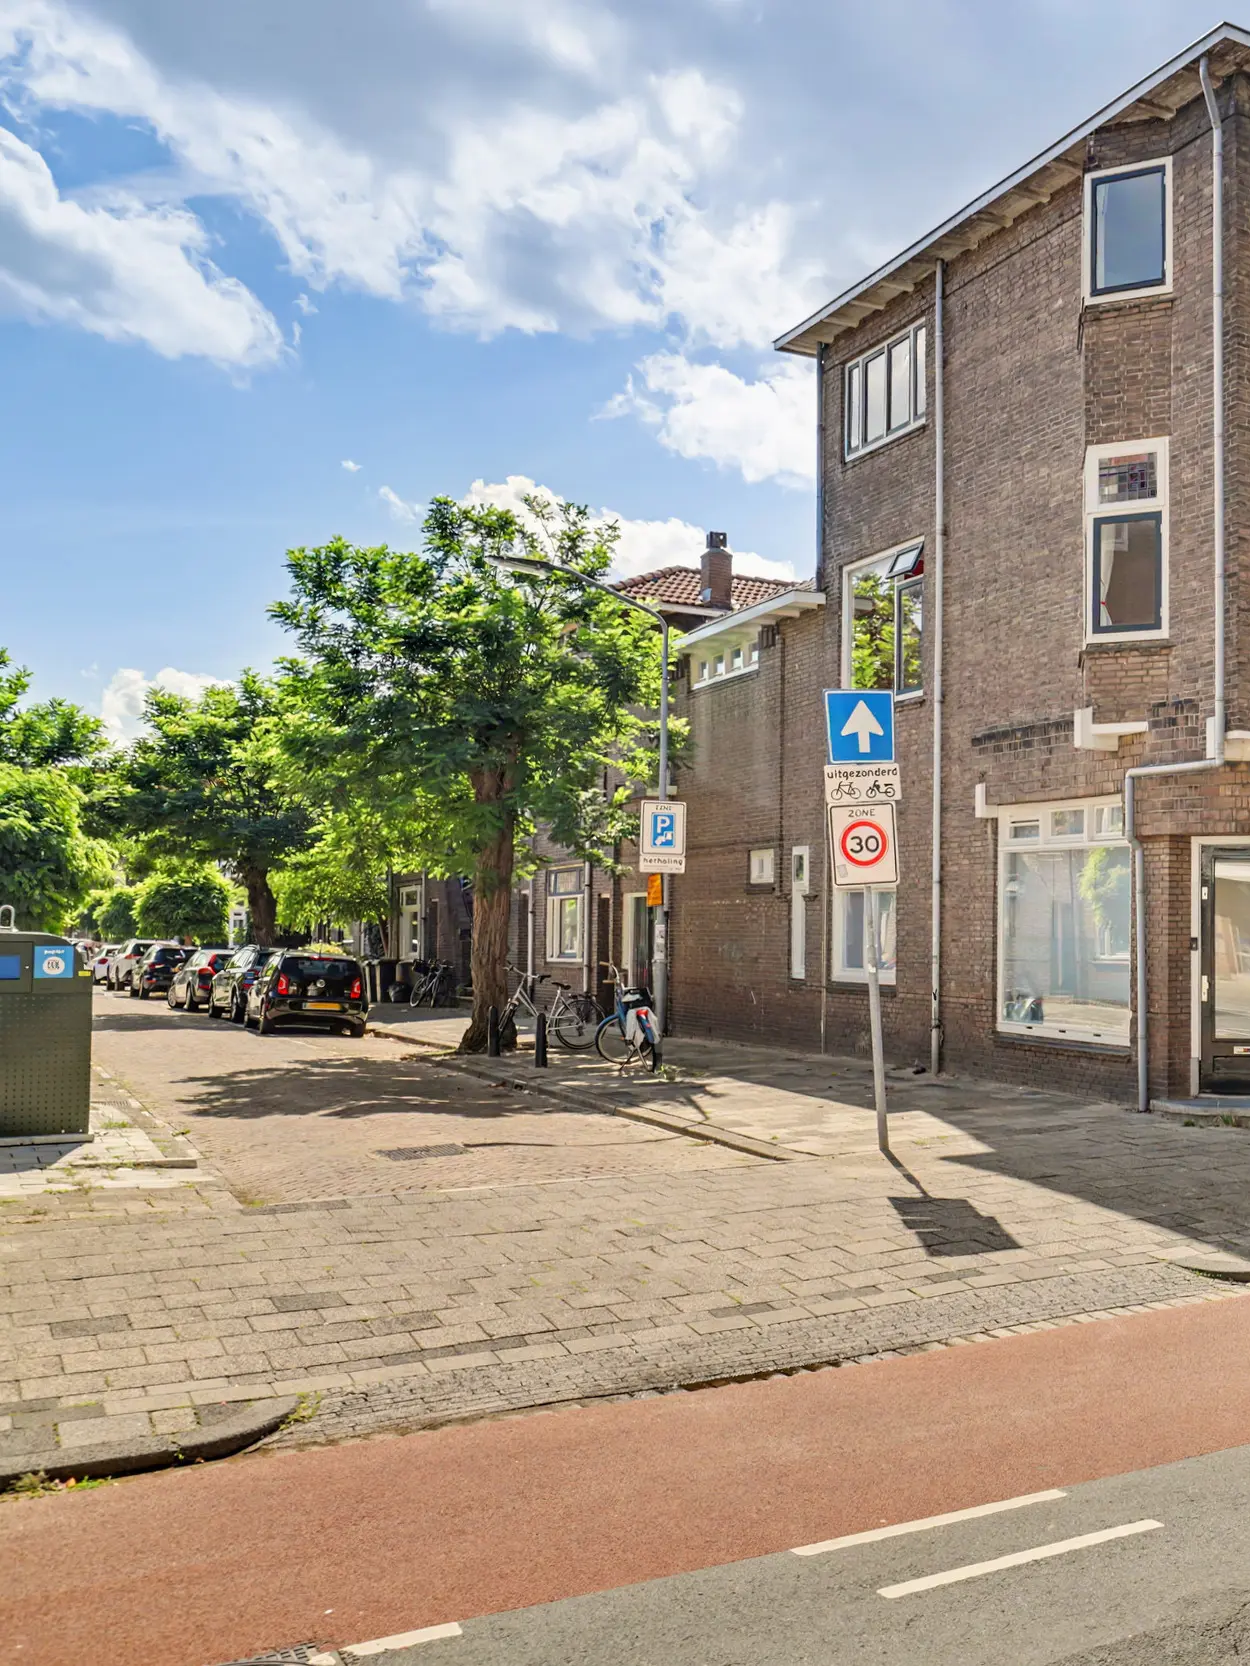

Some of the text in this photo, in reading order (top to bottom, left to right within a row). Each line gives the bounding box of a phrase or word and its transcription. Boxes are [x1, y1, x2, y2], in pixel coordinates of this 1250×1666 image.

[827, 768, 898, 780] uitgezonderd
[848, 809, 876, 818] ZONE
[656, 816, 670, 834] P
[850, 835, 879, 854] 30
